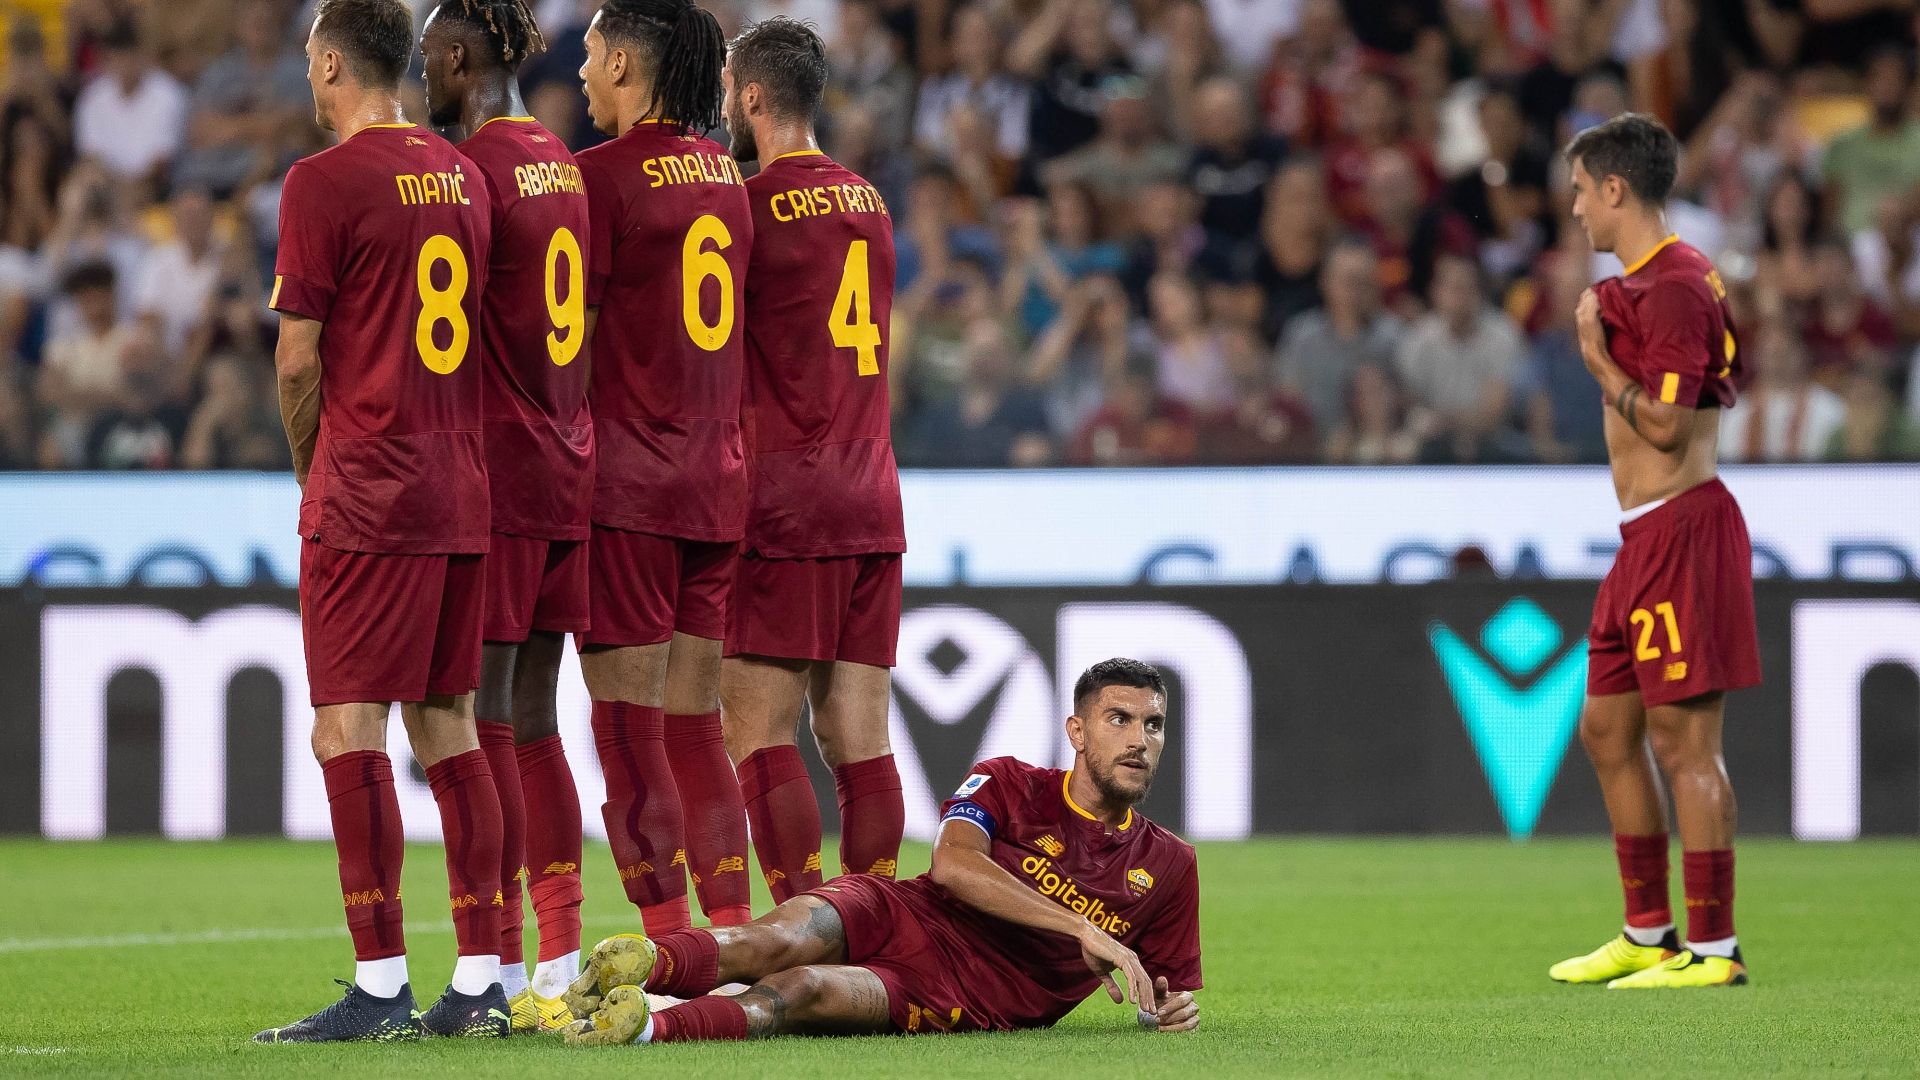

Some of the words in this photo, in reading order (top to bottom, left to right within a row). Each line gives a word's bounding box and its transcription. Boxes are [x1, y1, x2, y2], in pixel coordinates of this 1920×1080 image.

[395, 165, 470, 206] MATIĆ
[642, 151, 745, 188] SMALLIN
[416, 234, 469, 375] 8
[545, 227, 585, 366] 9
[682, 214, 734, 351] 6
[828, 240, 881, 376] 4
[1630, 602, 1682, 662] 21
[1022, 856, 1131, 936] digitalbits
